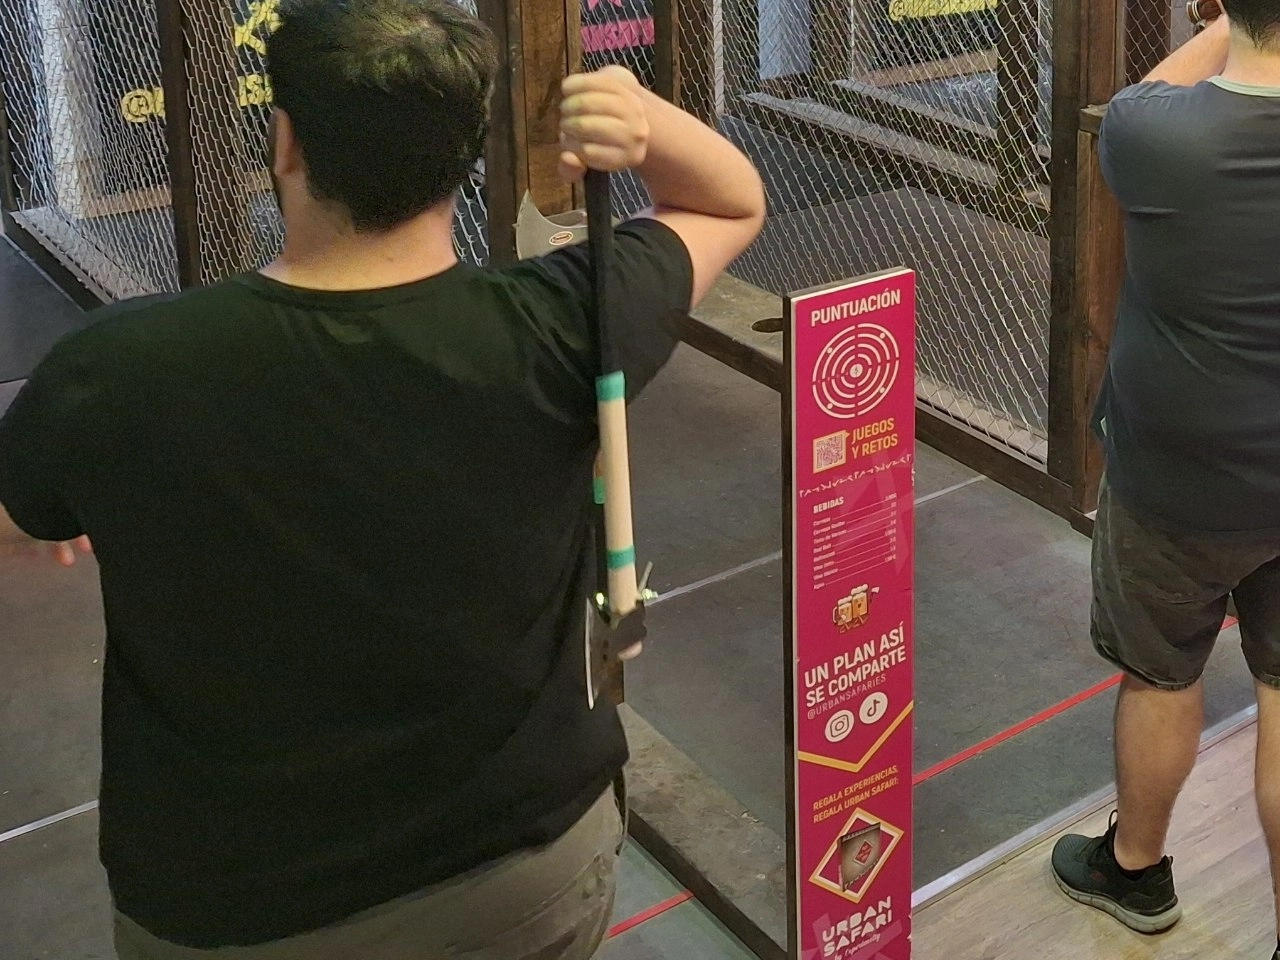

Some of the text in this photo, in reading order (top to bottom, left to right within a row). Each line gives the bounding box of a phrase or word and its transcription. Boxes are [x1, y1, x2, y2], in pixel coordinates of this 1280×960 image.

[811, 288, 900, 327] PUNTUACIÓN
[851, 417, 895, 444] JUEGOS
[852, 433, 898, 459] Y RETOS
[813, 496, 844, 514] BEBIDAS
[804, 621, 904, 688] UN PLAN ASÍ
[806, 645, 907, 708] SE COMPARTE
[807, 673, 887, 720] @URBANSAFARIES
[813, 790, 843, 811] REGALA
[813, 803, 843, 824] REGALA
[844, 790, 870, 809] URBAN
[822, 895, 891, 943] URBAN
[824, 909, 892, 957] SAFARI
